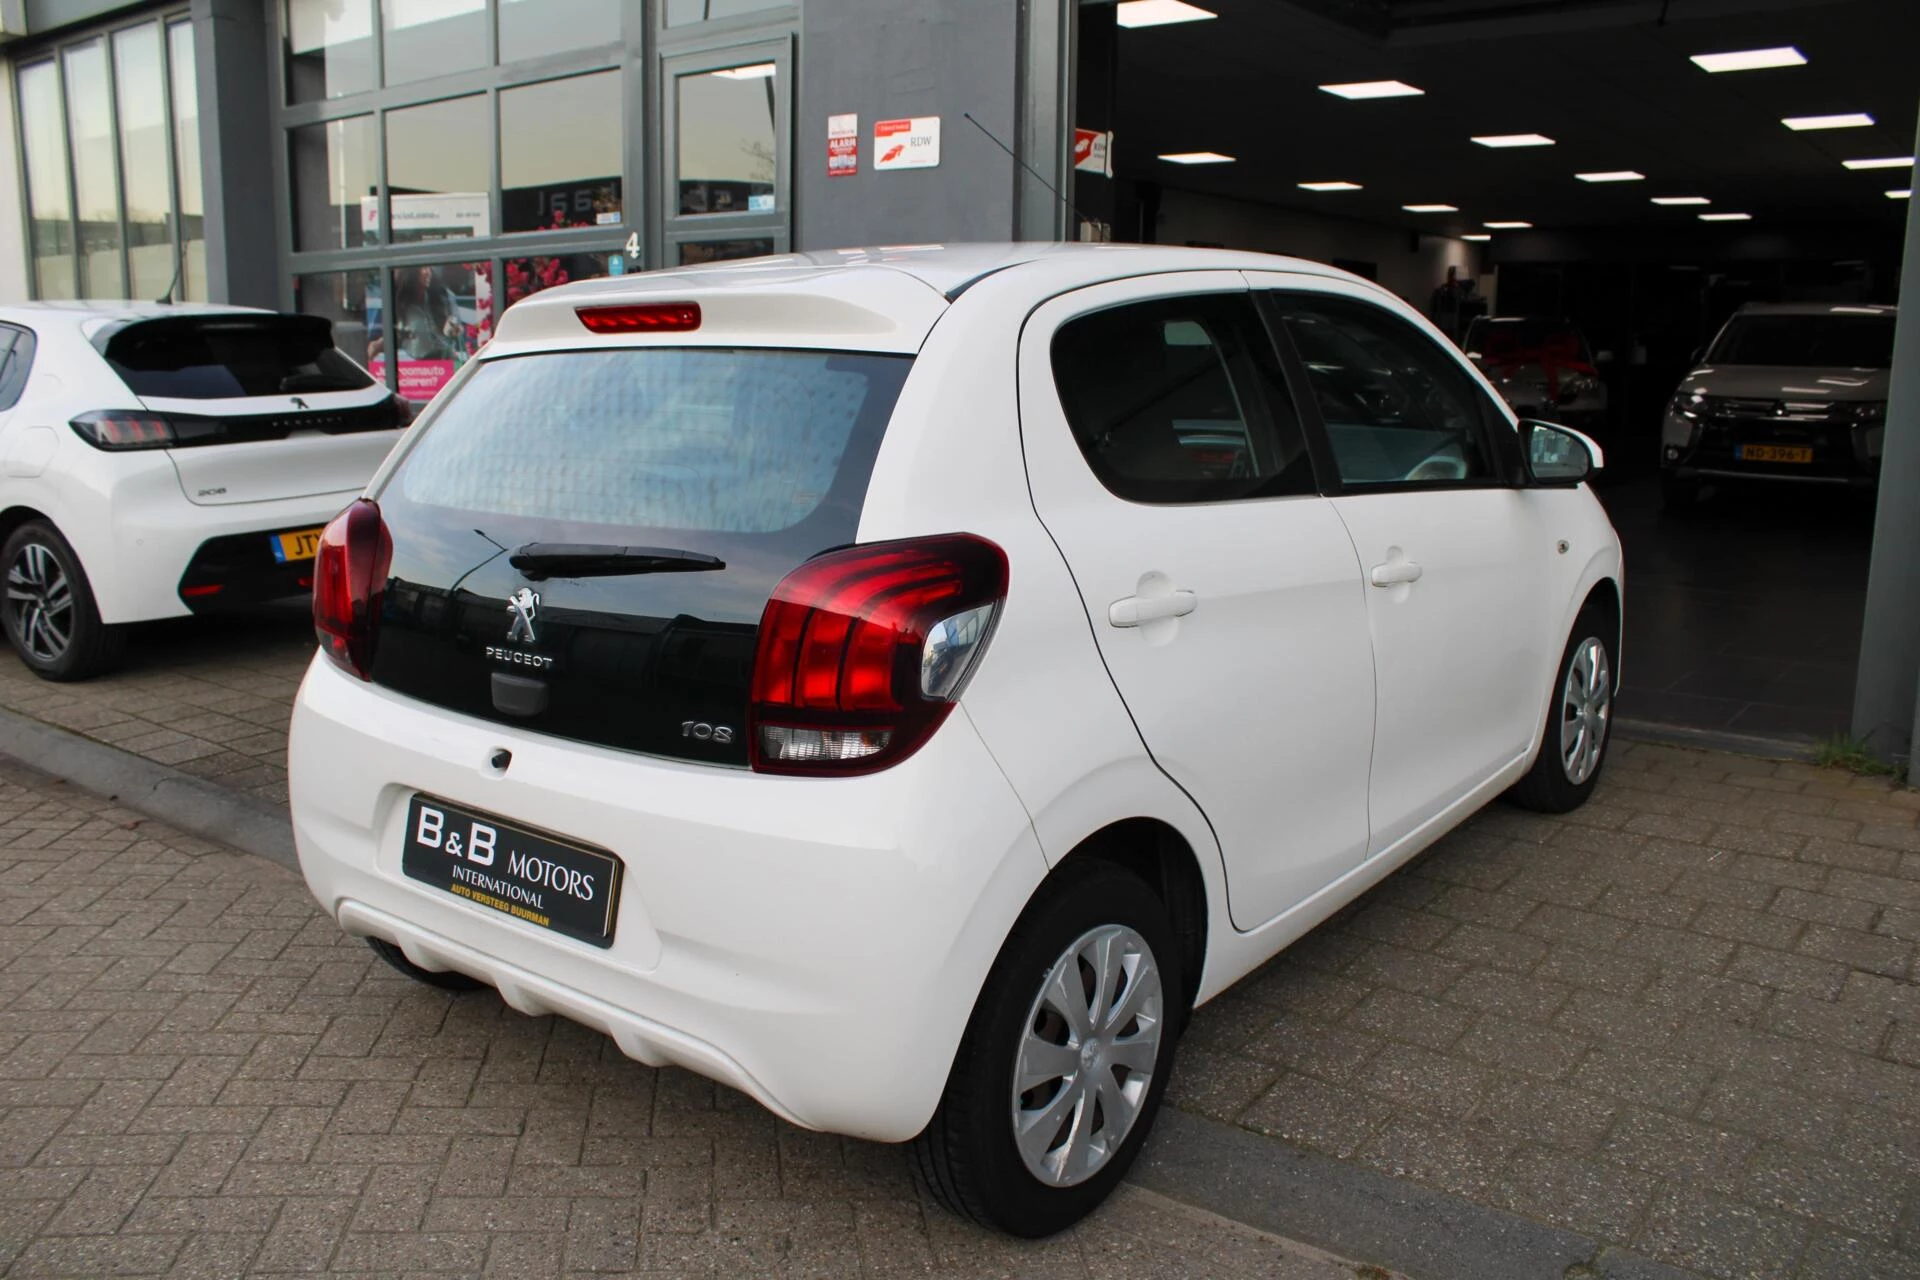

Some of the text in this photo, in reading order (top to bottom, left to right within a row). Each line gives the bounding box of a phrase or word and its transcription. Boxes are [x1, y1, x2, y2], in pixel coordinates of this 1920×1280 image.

[830, 137, 857, 149] ALARM
[911, 135, 932, 147] RDW
[625, 231, 640, 259] 4
[486, 646, 553, 669] PEUGEOT
[681, 721, 733, 743] 108
[452, 864, 545, 910] INTERNATIONAL
[507, 850, 595, 901] MOTORS
[450, 883, 550, 927] AUTO VERSTEEG BUURMAN
